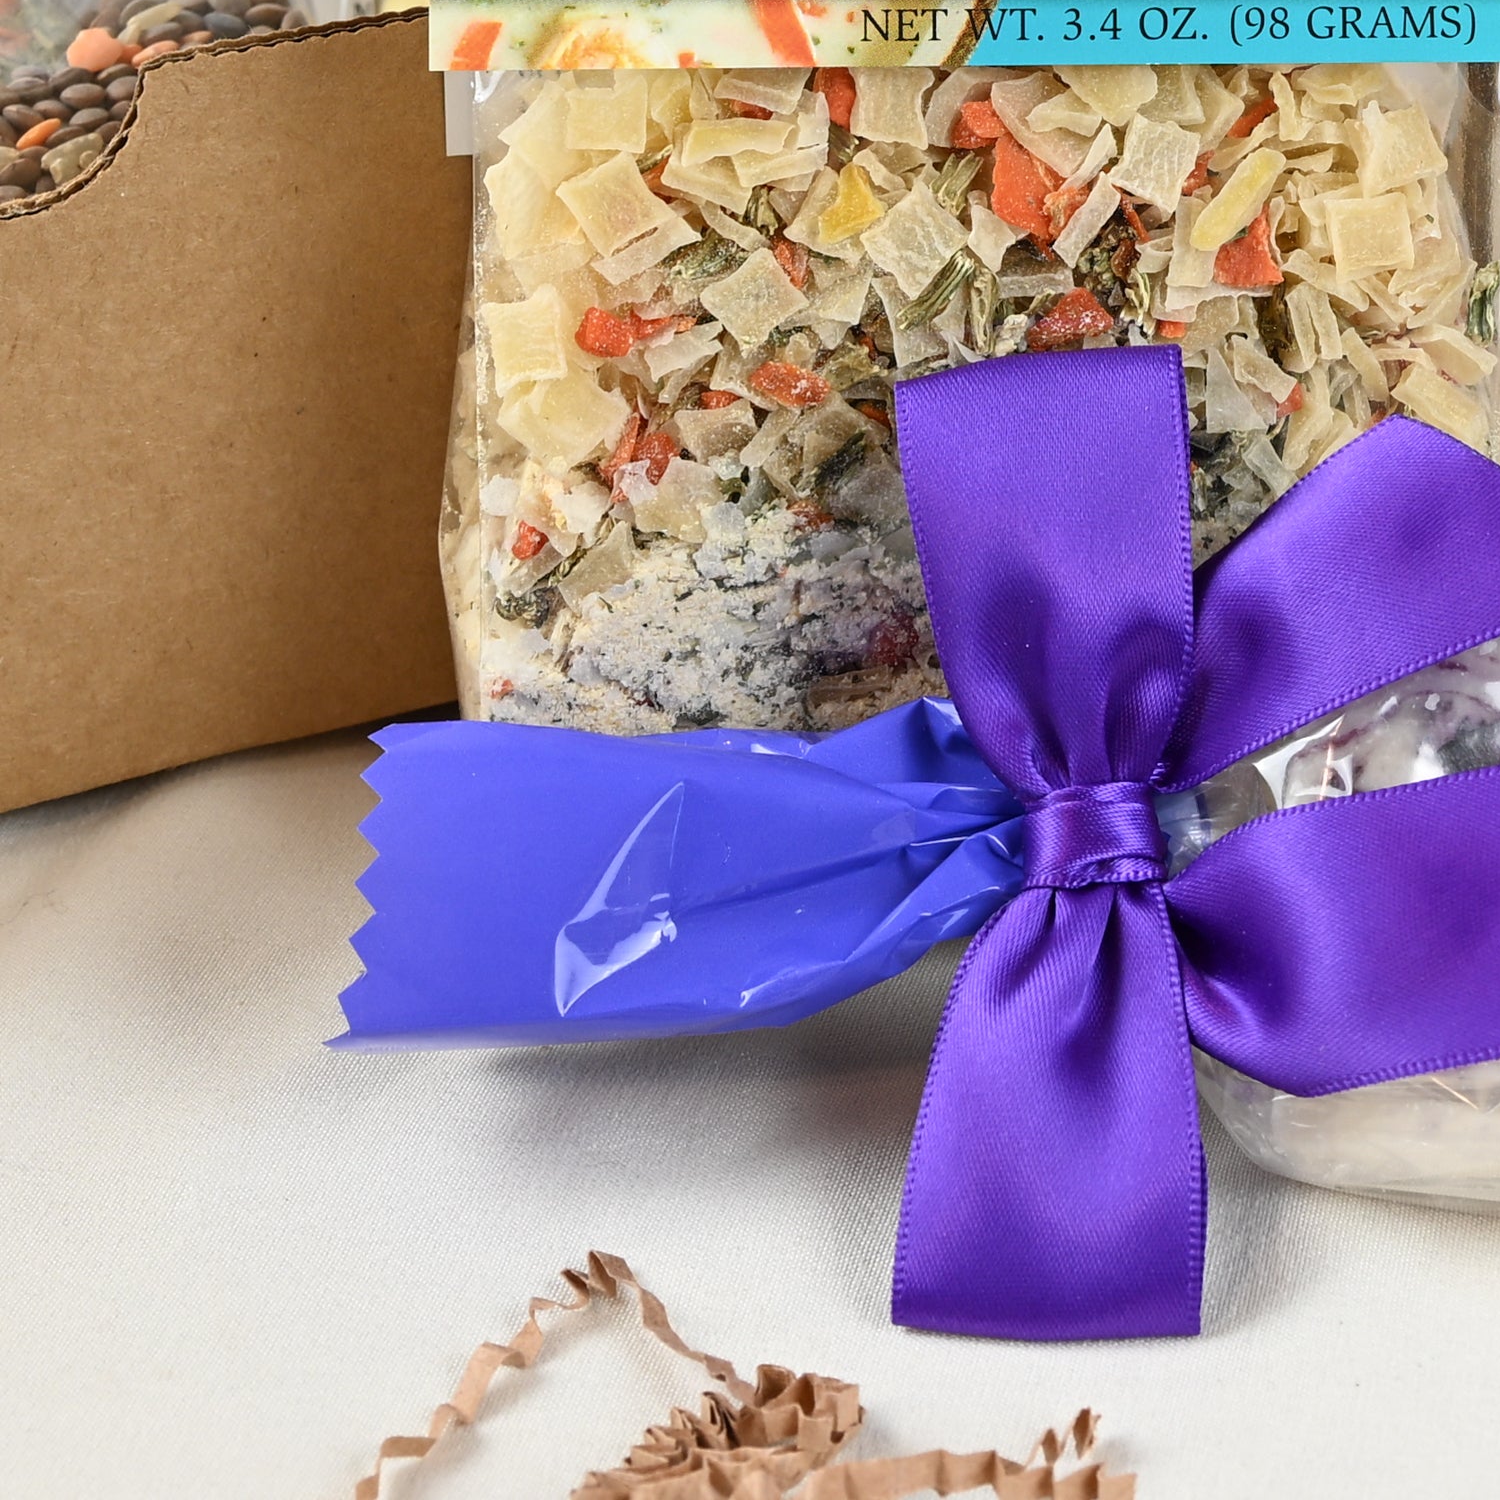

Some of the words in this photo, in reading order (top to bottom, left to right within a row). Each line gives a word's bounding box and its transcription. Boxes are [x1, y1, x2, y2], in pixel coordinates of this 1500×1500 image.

[860, 8, 948, 42] NET
[965, 8, 1045, 41] WT.
[1063, 8, 1122, 41] 3.4
[1139, 6, 1209, 41] OZ.
[1230, 4, 1291, 46] (98
[1306, 3, 1477, 46] GRAMS)
